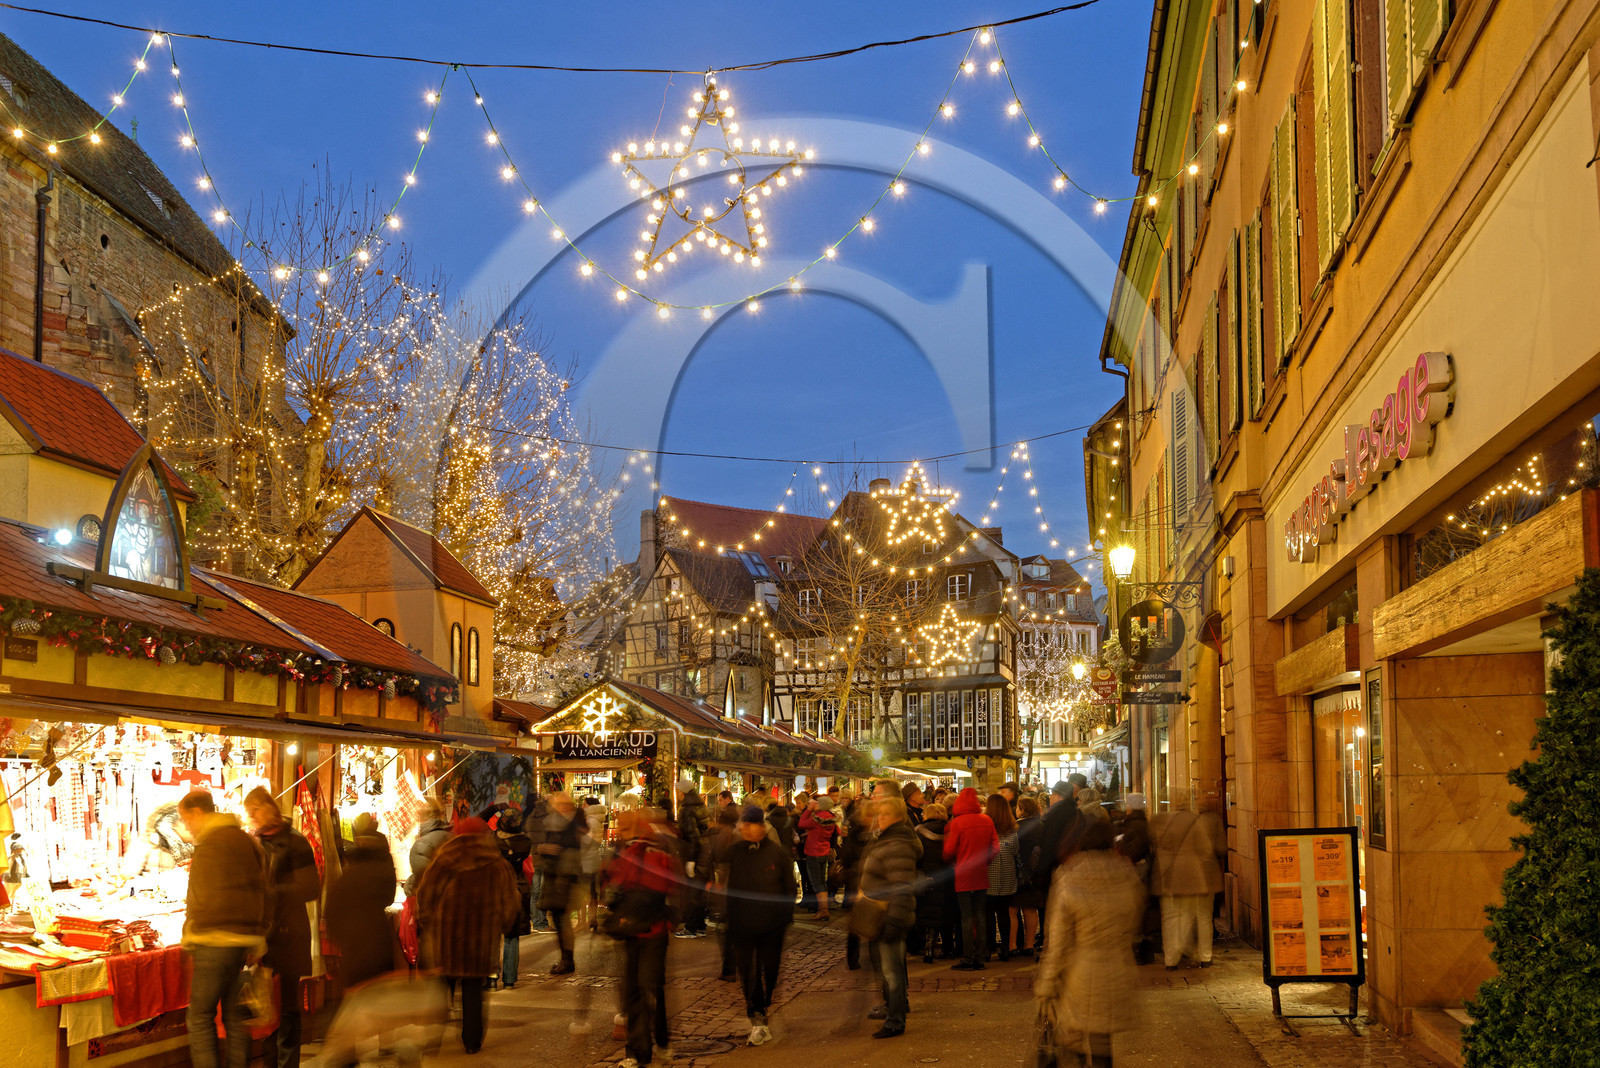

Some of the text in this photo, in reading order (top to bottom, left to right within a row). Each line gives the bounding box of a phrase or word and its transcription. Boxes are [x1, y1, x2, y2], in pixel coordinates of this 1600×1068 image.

[1344, 352, 1438, 500] Lesage
[558, 731, 656, 749] VIN CHAUD
[580, 748, 643, 757] L'ANCIENNE
